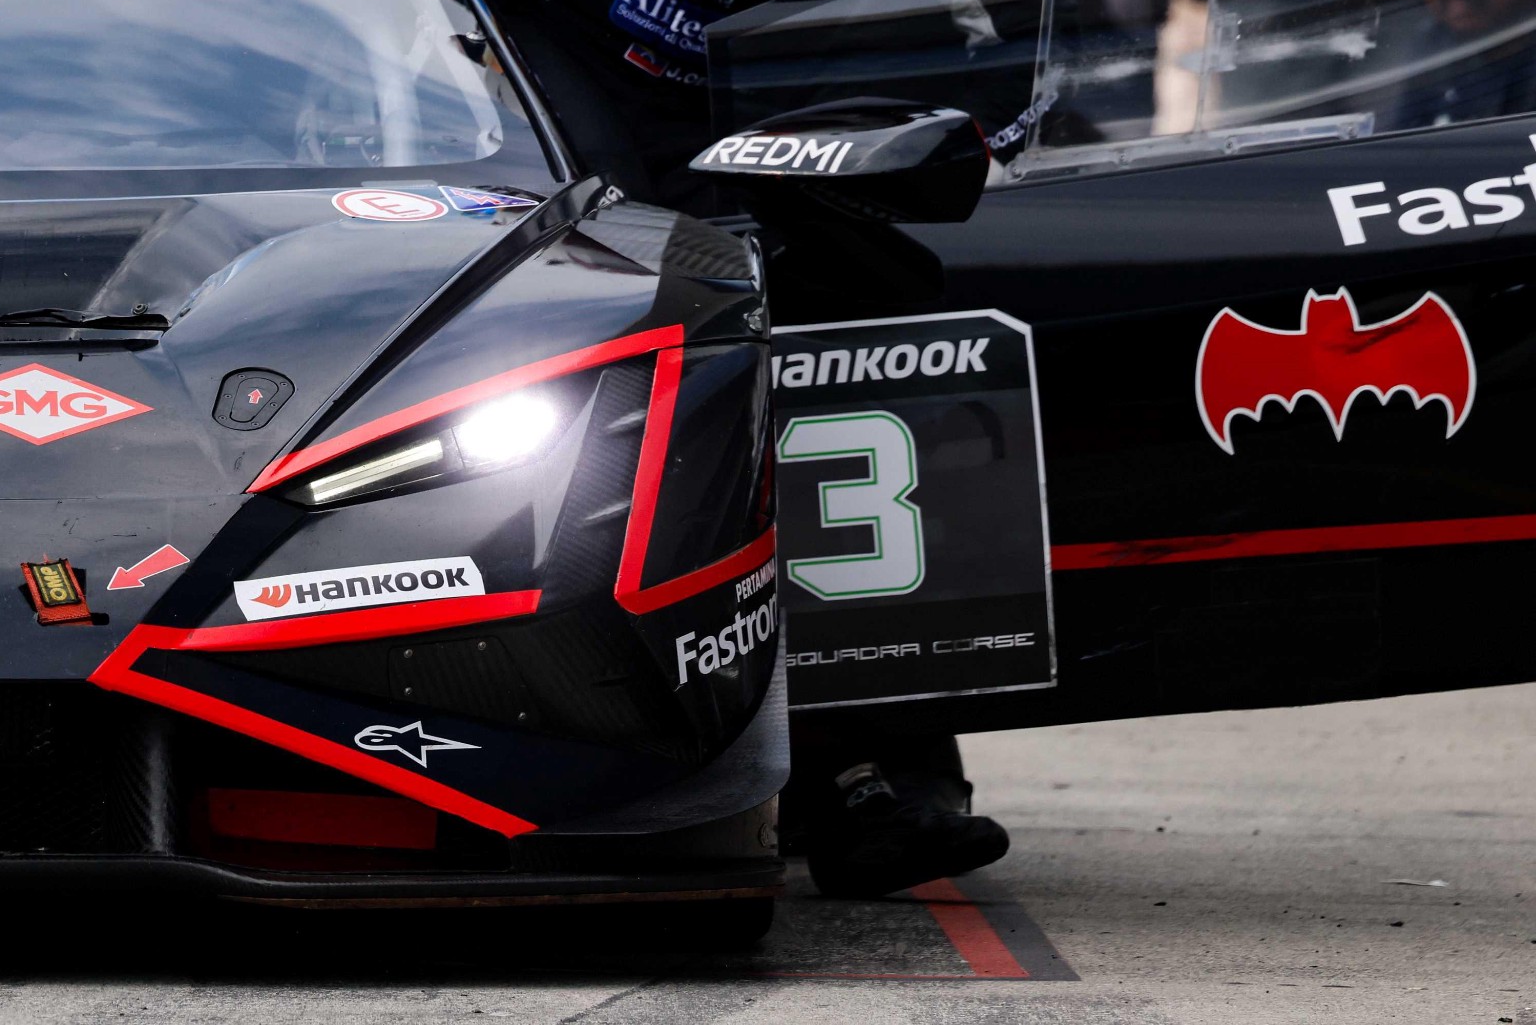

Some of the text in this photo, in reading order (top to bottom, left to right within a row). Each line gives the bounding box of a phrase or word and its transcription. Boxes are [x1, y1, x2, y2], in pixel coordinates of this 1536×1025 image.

[702, 136, 855, 174] REDMI
[776, 410, 926, 601] 3
[39, 566, 68, 602] OMP
[675, 592, 779, 685] Fastron
[785, 632, 1036, 667] SQUADRA CORSE
